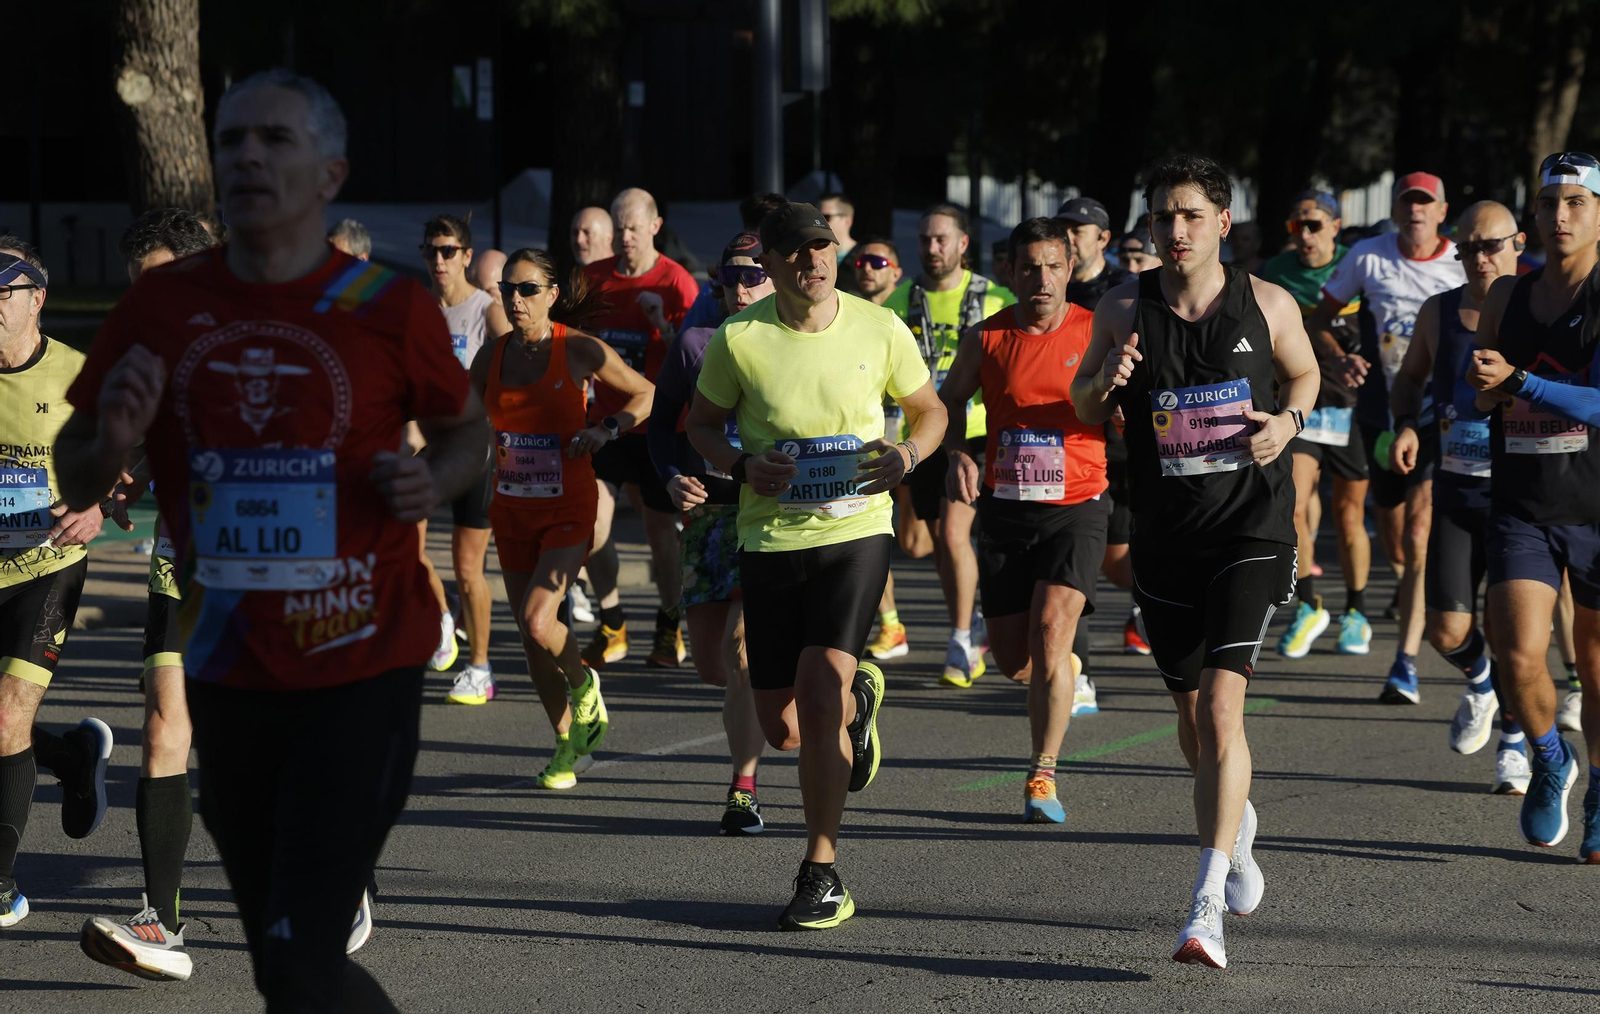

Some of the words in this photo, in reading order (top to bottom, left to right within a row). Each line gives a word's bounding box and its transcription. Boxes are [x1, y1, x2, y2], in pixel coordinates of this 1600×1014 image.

[611, 332, 641, 341] ZURICH
[1184, 387, 1238, 404] ZURICH
[1189, 417, 1219, 429] 9190
[1504, 421, 1535, 434] FRAN
[514, 437, 551, 447] ZURICH
[1014, 434, 1056, 444] ZURICH
[806, 440, 857, 454] ZURICH
[1160, 442, 1193, 456] JUAN
[515, 456, 535, 466] 9944
[1013, 454, 1036, 464] 8007
[233, 458, 318, 477] ZURICH
[809, 465, 836, 479] 6180
[498, 469, 532, 483] MARISA
[994, 468, 1029, 483] ANGEL
[1034, 469, 1064, 483] LUIS
[790, 480, 857, 500] ARTURO
[236, 498, 279, 518] 6864
[216, 526, 249, 553] AL
[257, 526, 302, 553] LIO
